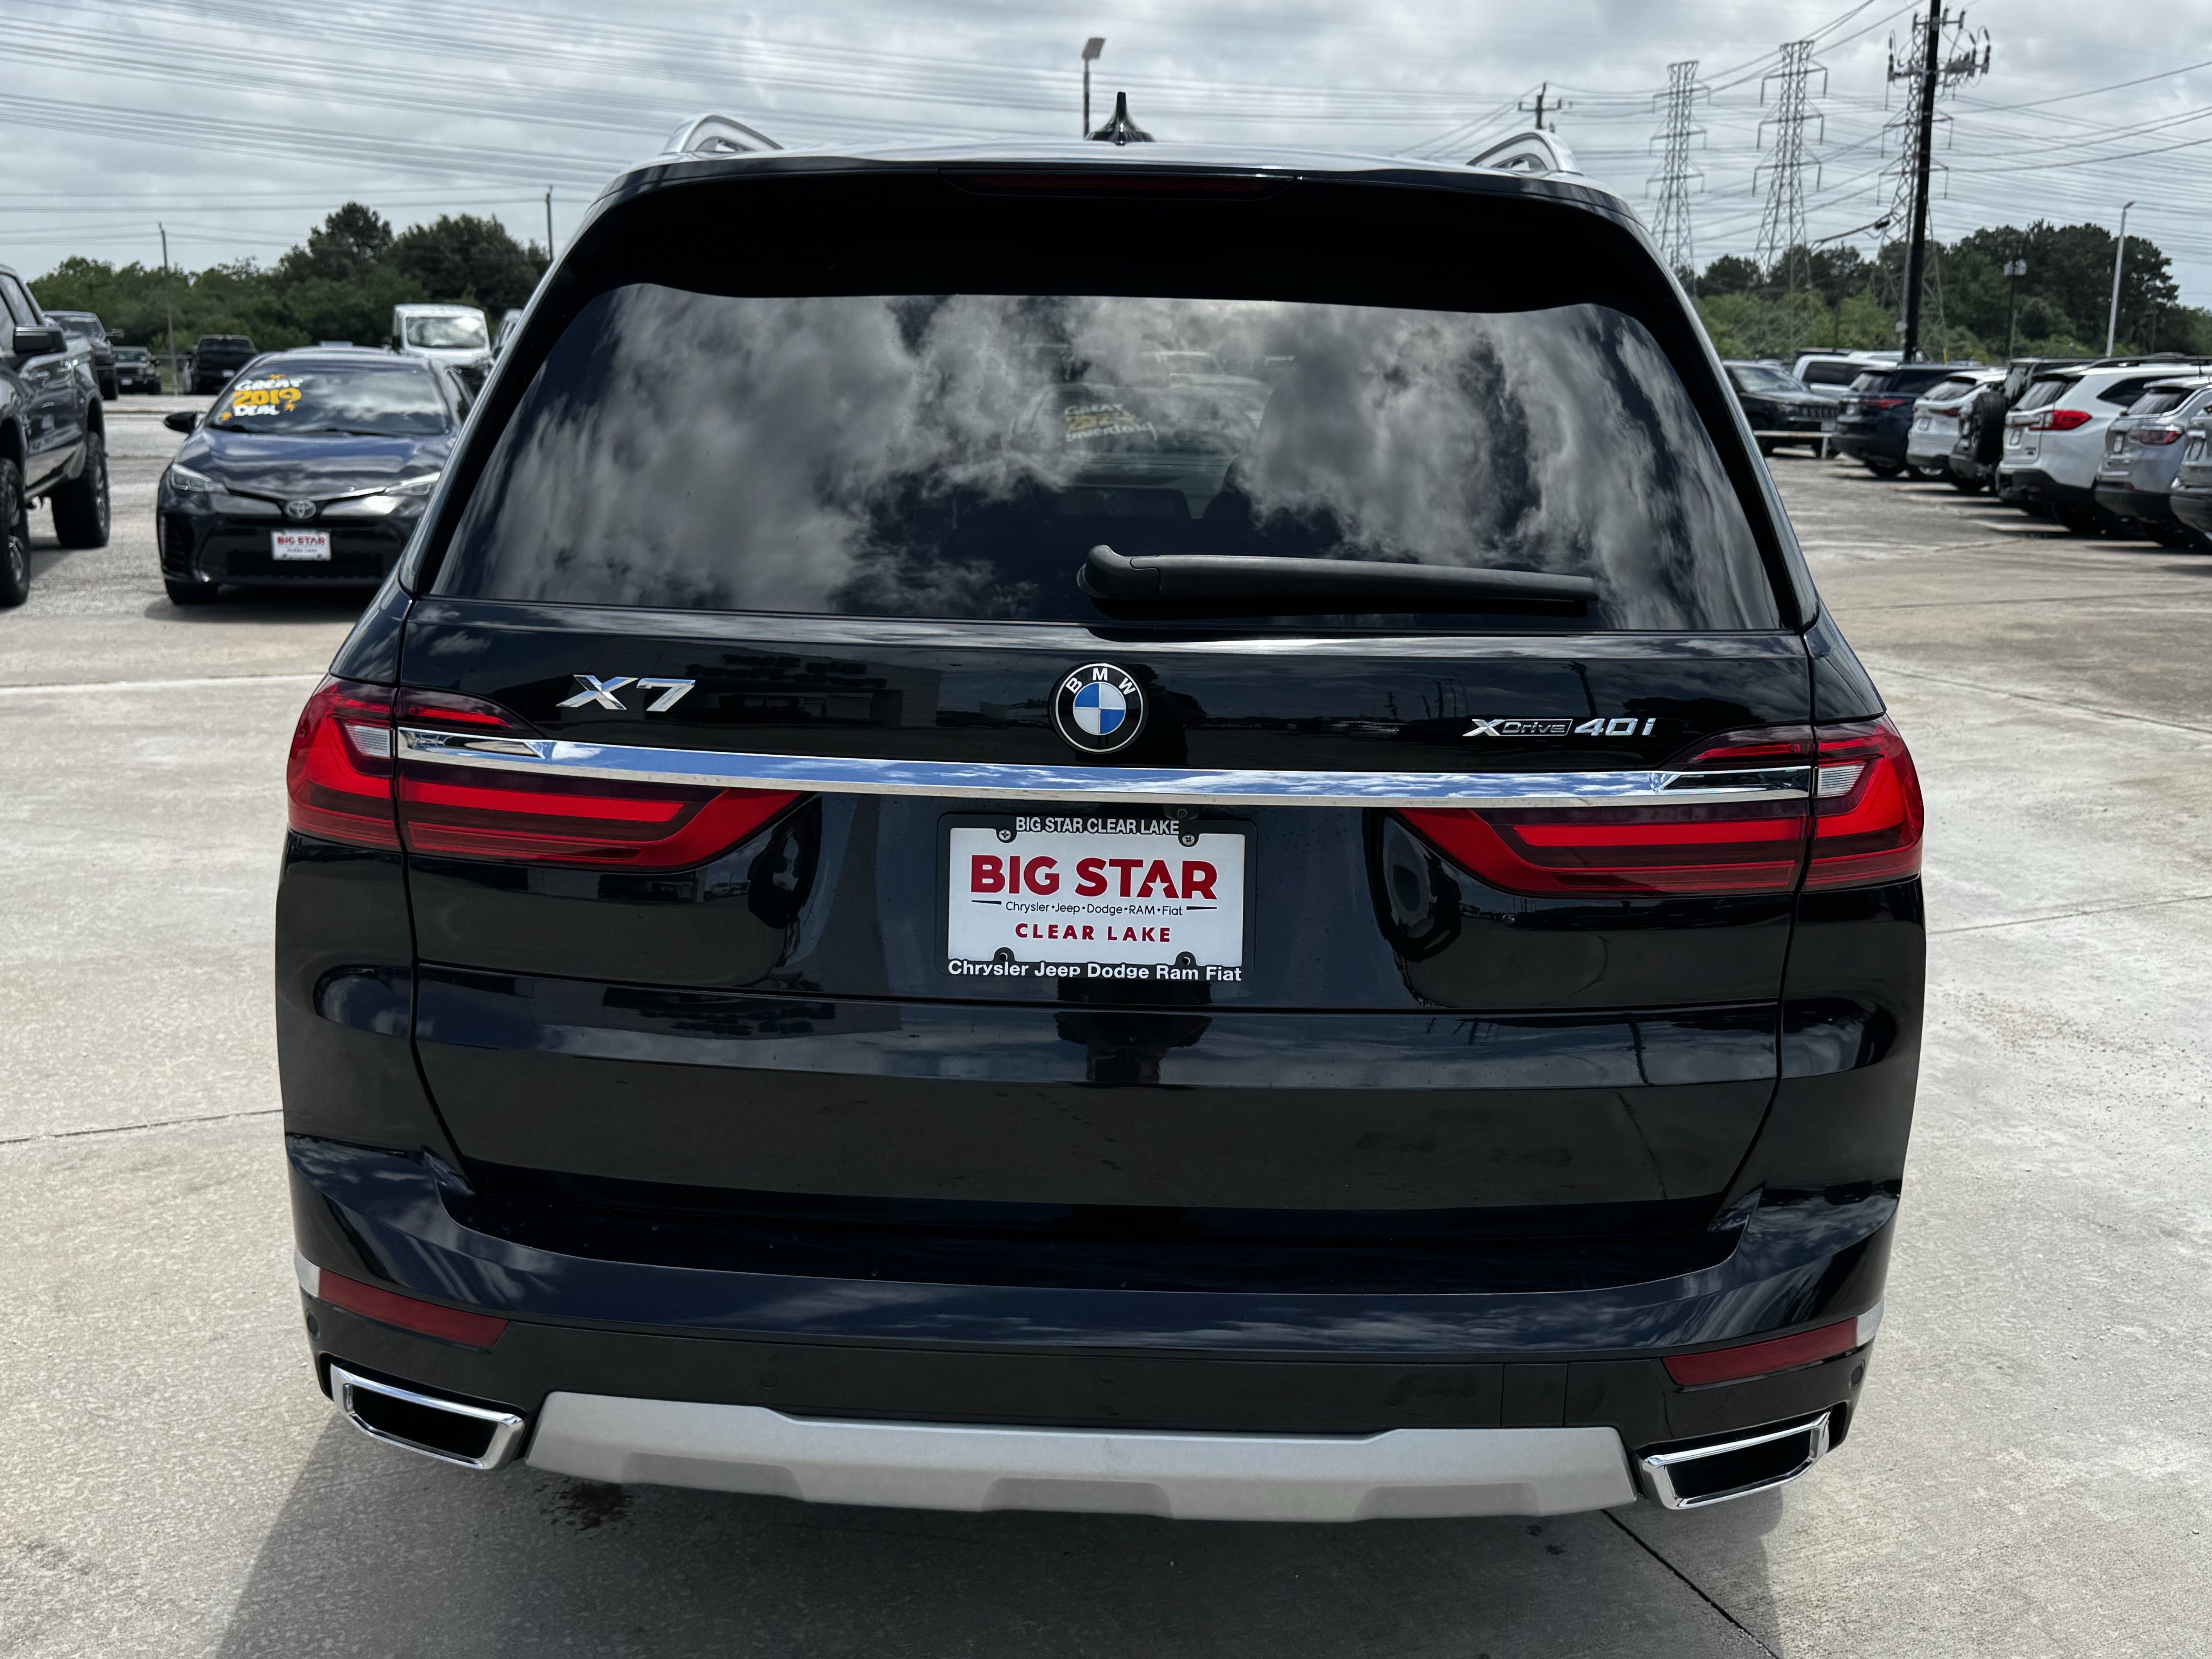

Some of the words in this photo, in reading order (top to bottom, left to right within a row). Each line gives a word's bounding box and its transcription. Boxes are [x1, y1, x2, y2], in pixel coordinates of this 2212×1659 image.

[556, 674, 696, 712] X7
[1065, 668, 1136, 695] BMW
[1016, 817, 1041, 832] BIG
[1045, 817, 1083, 833] STAR
[1087, 818, 1139, 835] CLEAR
[1140, 819, 1179, 835] LAKE
[971, 854, 1060, 896] BIG
[1075, 857, 1218, 900] STAR
[1015, 923, 1095, 941] CLEAR
[1108, 926, 1170, 943] LAKE
[948, 960, 1029, 976] Chrysler
[1034, 962, 1081, 978] Jeep
[1087, 962, 1149, 979] Dodge
[1156, 965, 1199, 980] Ram
[1206, 967, 1242, 981] Fiat
